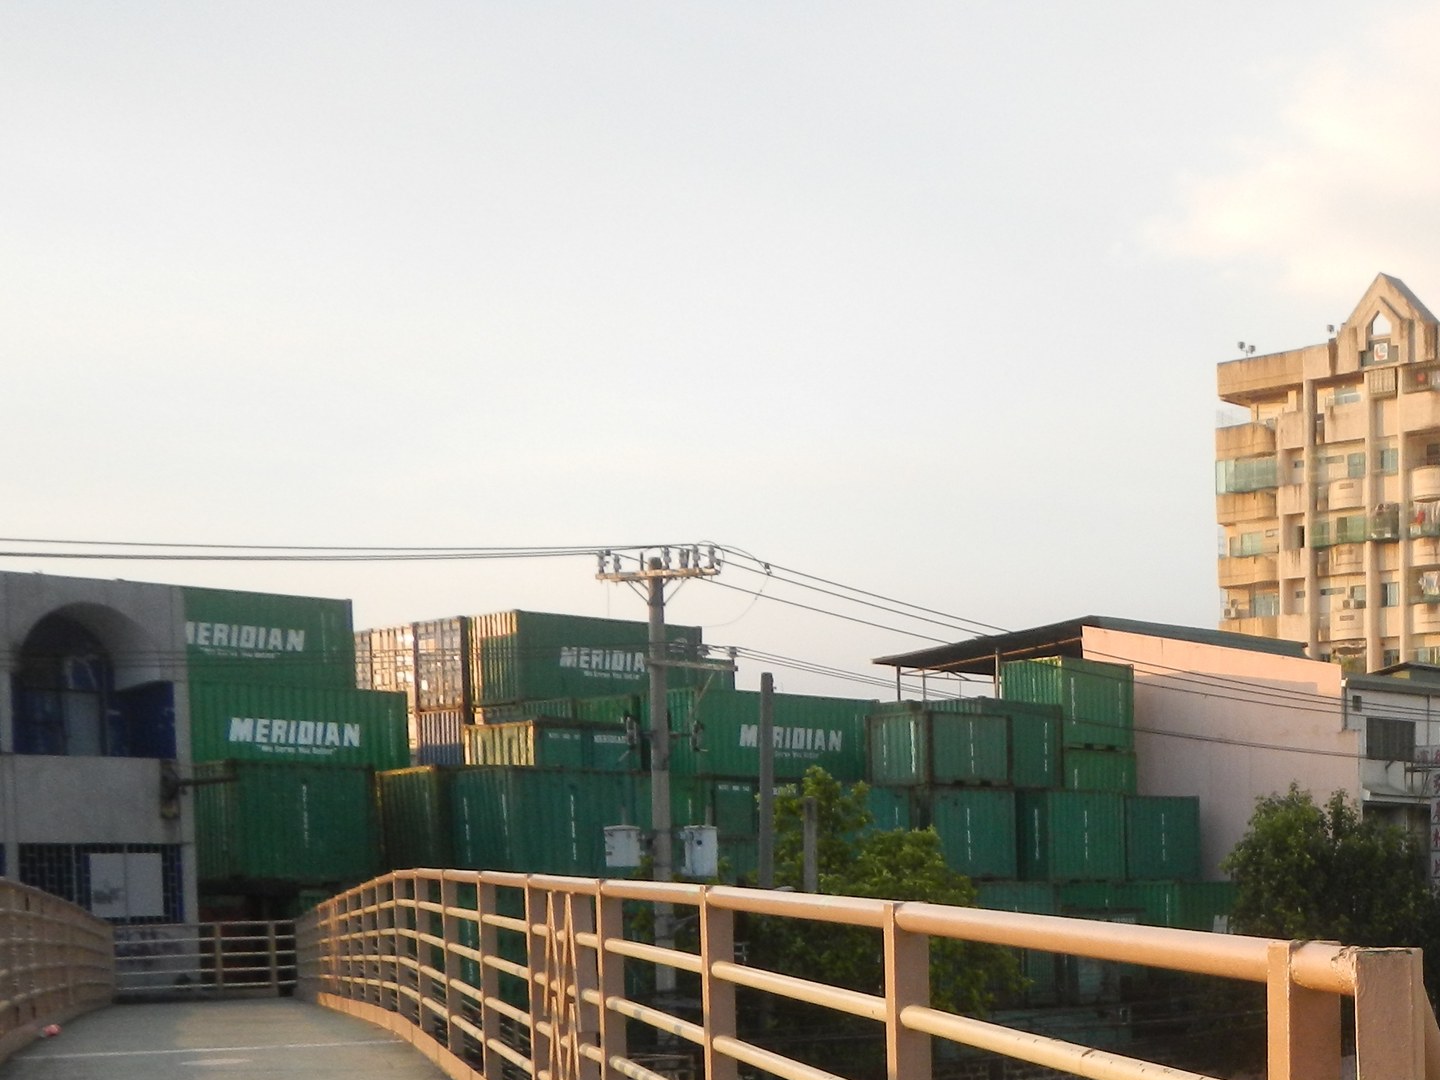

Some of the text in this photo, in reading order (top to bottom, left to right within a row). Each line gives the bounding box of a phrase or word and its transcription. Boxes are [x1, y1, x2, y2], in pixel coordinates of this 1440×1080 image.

[560, 646, 646, 672] MERIDIA
[229, 717, 361, 747] MERIDIAN
[740, 724, 842, 751] MRIDIAN
